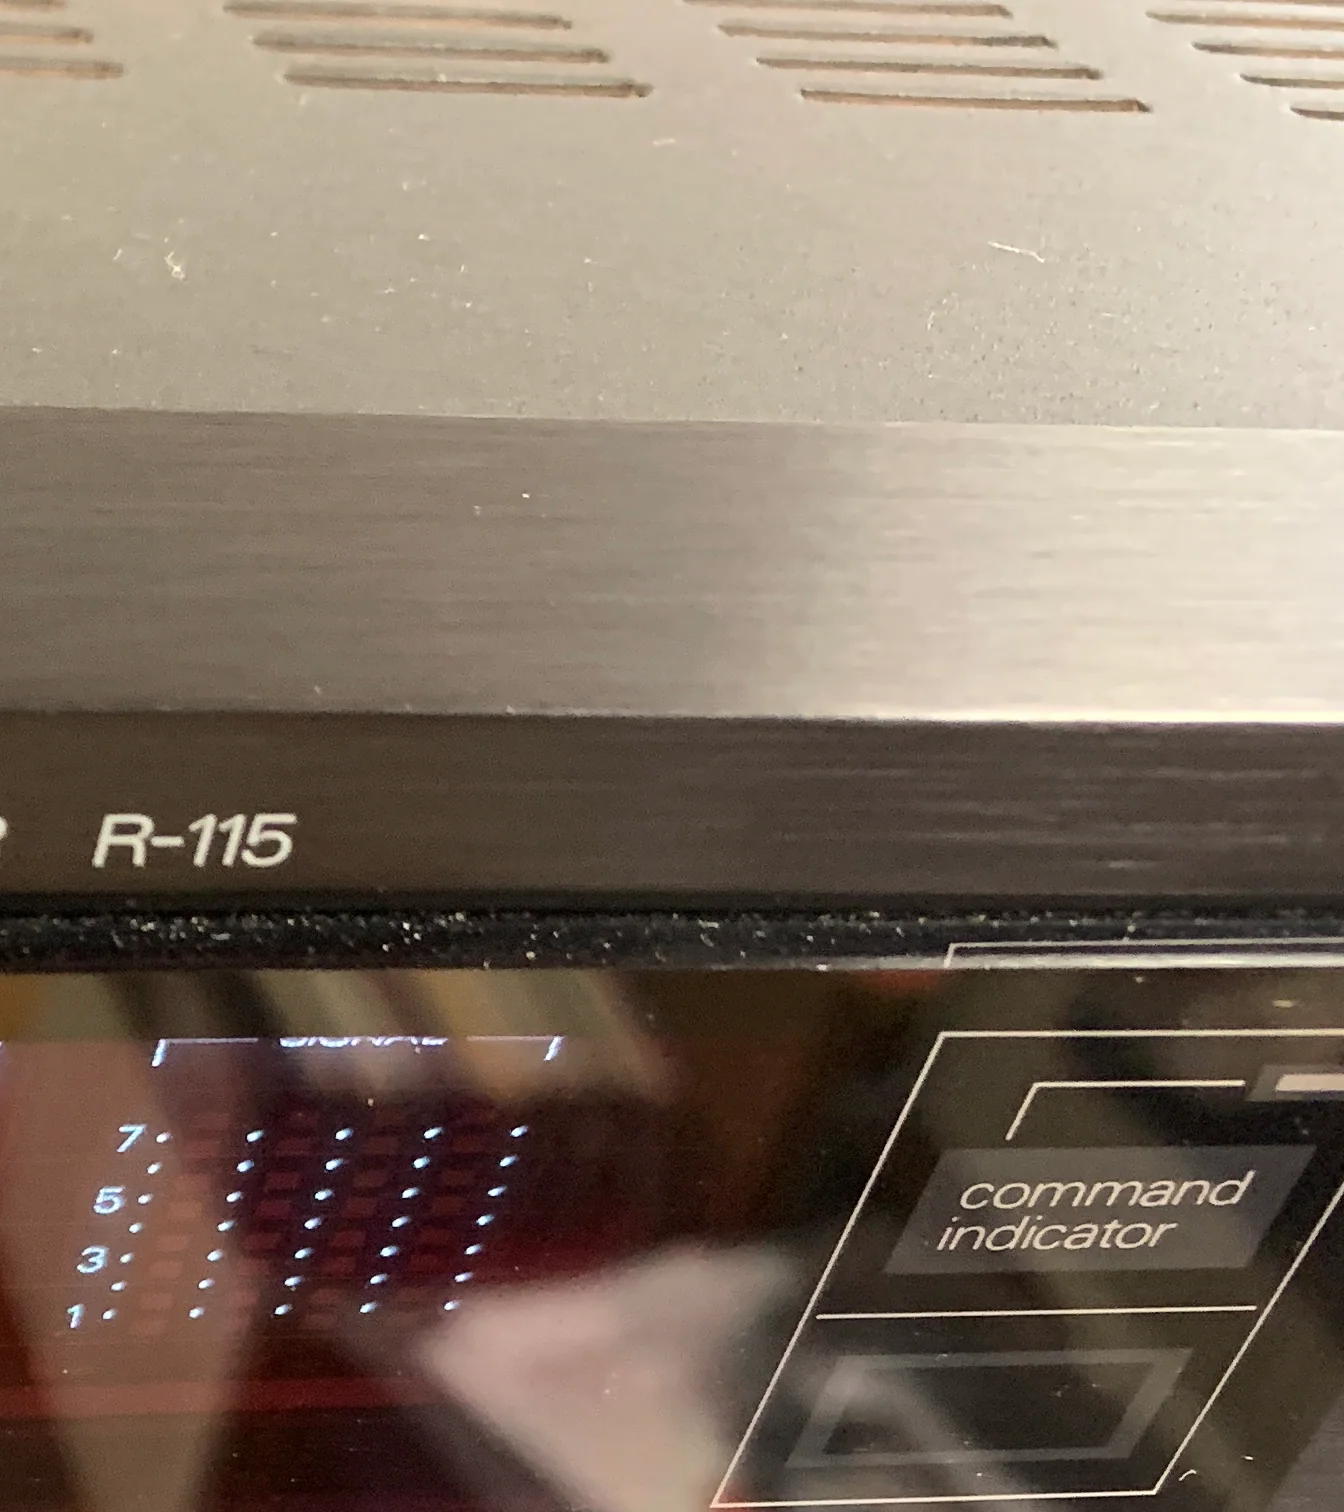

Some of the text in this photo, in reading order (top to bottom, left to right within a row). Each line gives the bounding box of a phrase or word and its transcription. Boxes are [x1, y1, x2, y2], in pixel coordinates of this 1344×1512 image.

[91, 813, 297, 867] R-115
[116, 1124, 146, 1153] 7
[93, 1186, 125, 1214] 5
[959, 1170, 1255, 1210] command
[936, 1215, 1177, 1250] indicator
[77, 1246, 108, 1273] 3
[66, 1304, 85, 1329] 1
